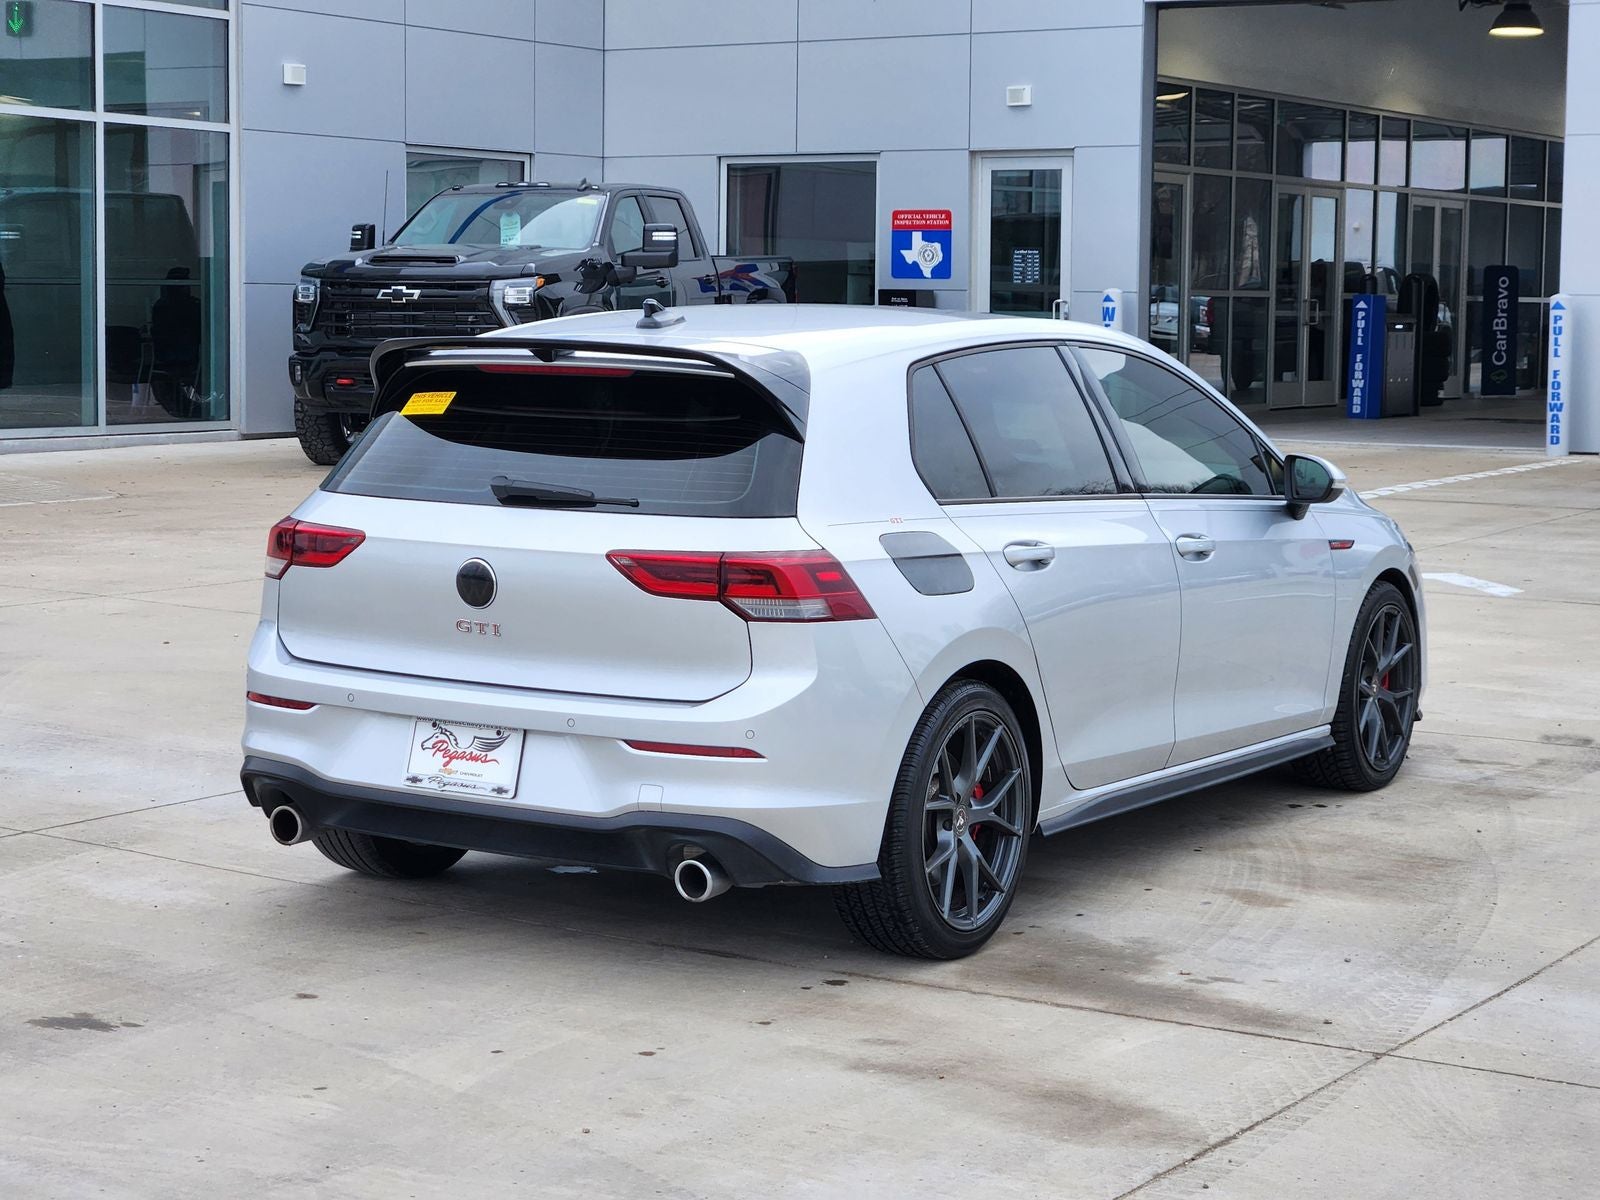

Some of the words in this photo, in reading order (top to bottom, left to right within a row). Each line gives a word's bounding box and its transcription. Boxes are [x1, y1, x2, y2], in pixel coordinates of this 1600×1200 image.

[1357, 311, 1366, 346] PULL
[1492, 276, 1510, 366] CarBravo
[1553, 314, 1563, 358] PULL
[1352, 353, 1365, 413] FORWARD
[1548, 369, 1564, 446] FORWARD
[456, 618, 501, 637] GTI
[431, 739, 500, 768] Pegasus
